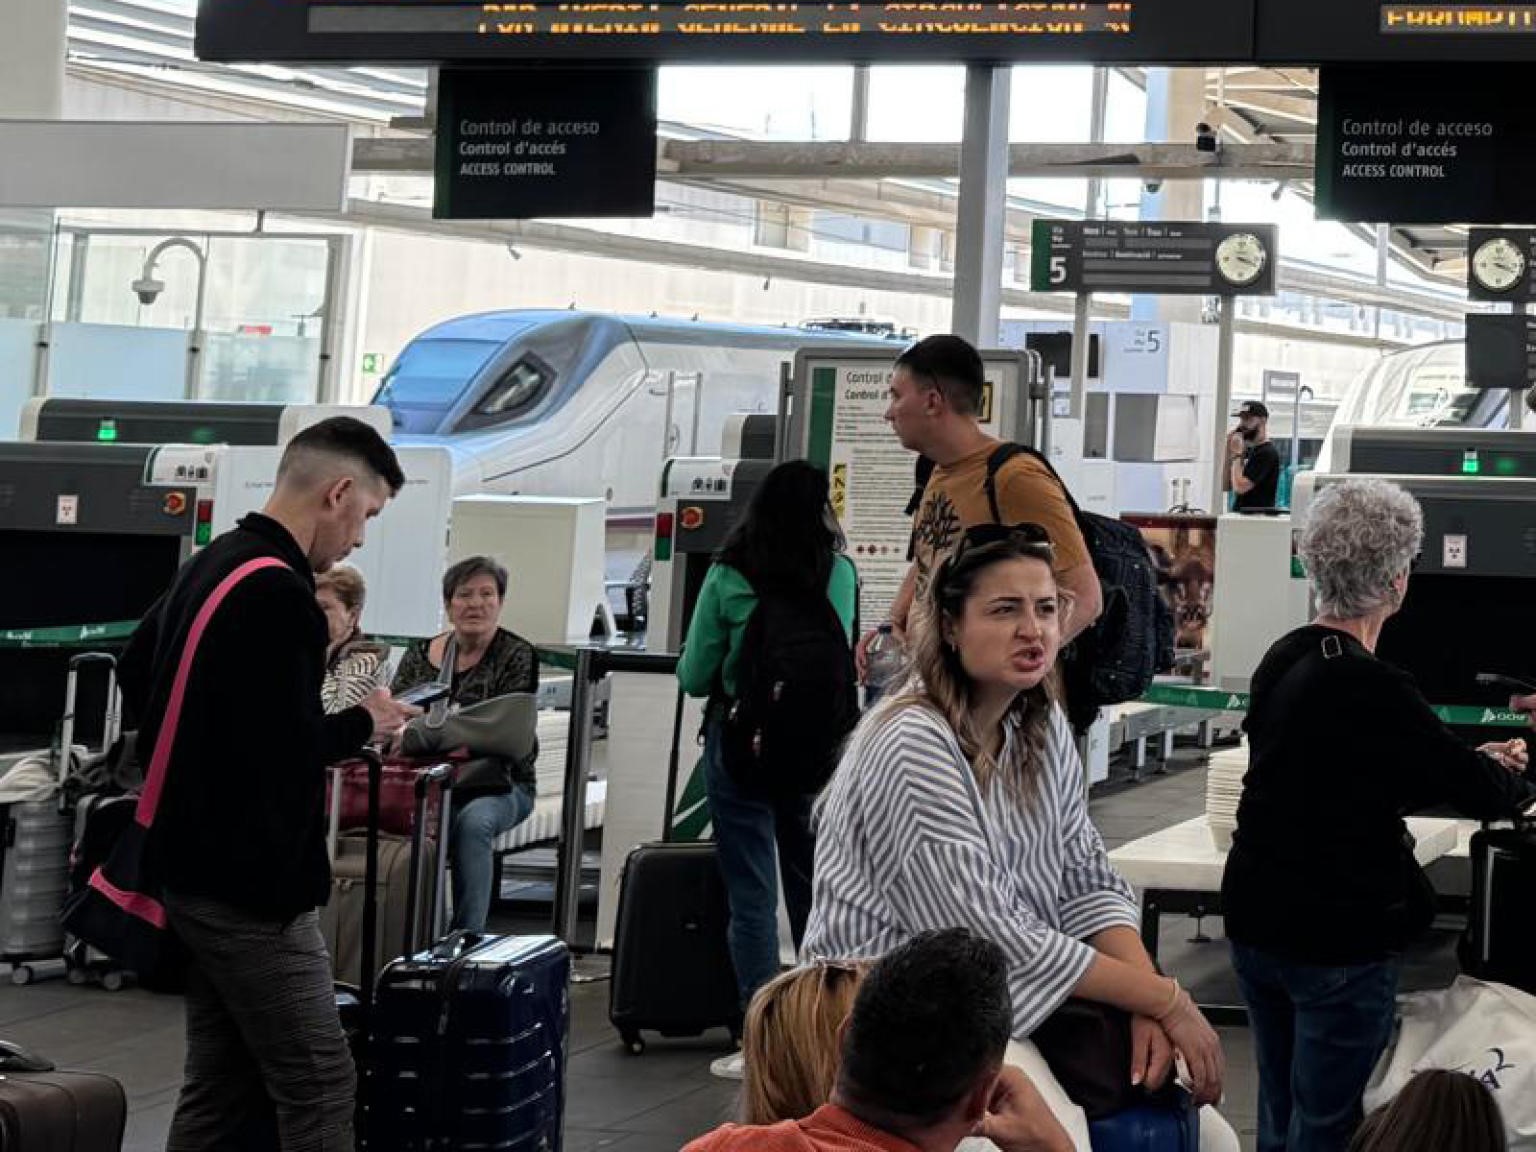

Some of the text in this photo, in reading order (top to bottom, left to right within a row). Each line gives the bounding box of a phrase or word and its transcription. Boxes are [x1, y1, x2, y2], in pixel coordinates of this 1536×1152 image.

[459, 119, 600, 136] Control de acceso
[1342, 118, 1493, 136] Control de acceso
[459, 140, 566, 155] Control d'accés
[1341, 140, 1458, 157] Control d'accés
[460, 162, 555, 176] ACCESS CONTROL
[1342, 164, 1446, 178] ACCESS CONTROL
[1049, 256, 1067, 283] 5
[1147, 329, 1161, 353] 5
